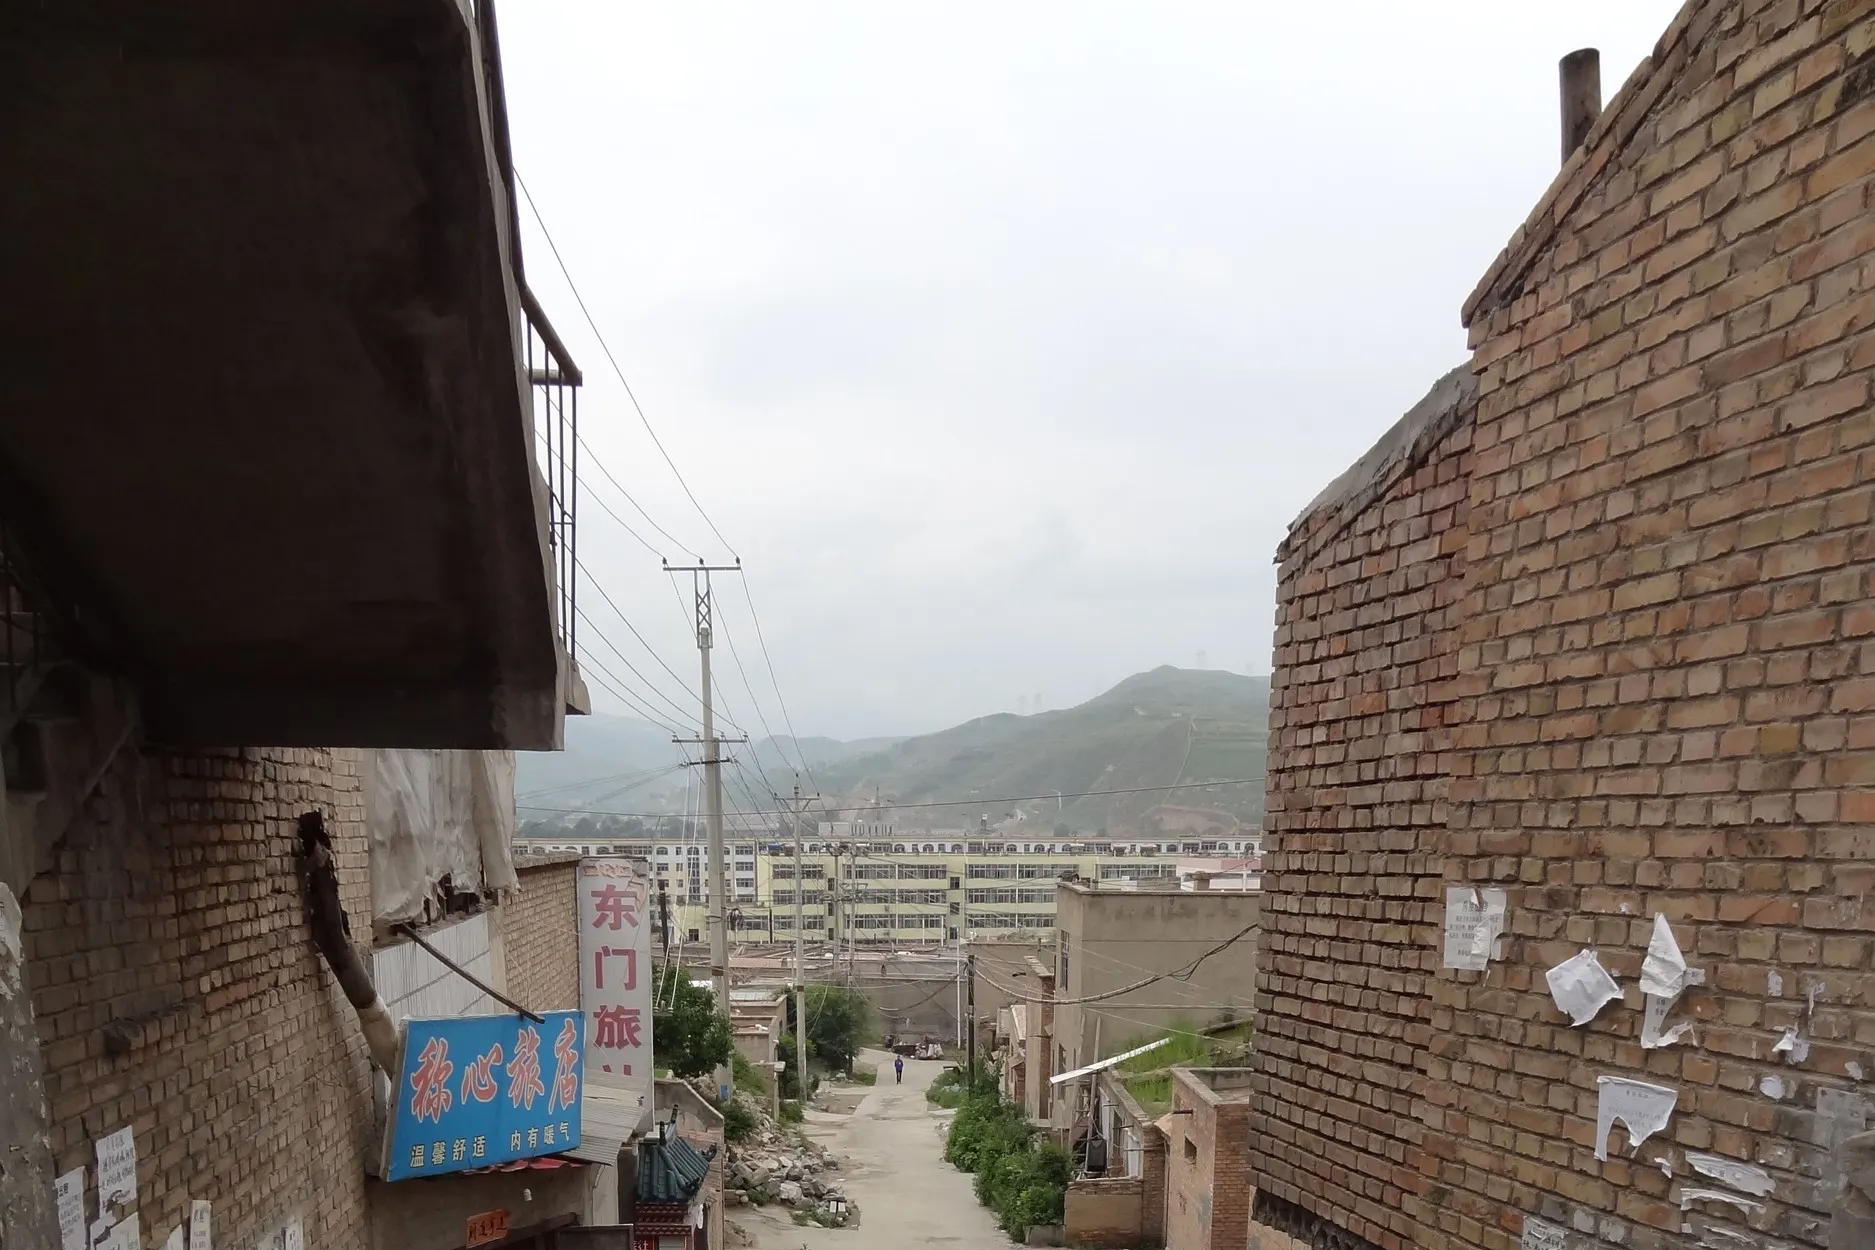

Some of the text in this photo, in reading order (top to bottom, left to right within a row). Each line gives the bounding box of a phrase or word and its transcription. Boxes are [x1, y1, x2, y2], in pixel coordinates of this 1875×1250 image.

[591, 884, 642, 1076] 东门旅
[411, 1018, 578, 1124] 称心旅店
[410, 1122, 570, 1168] 温馨舒适 内有暖气
